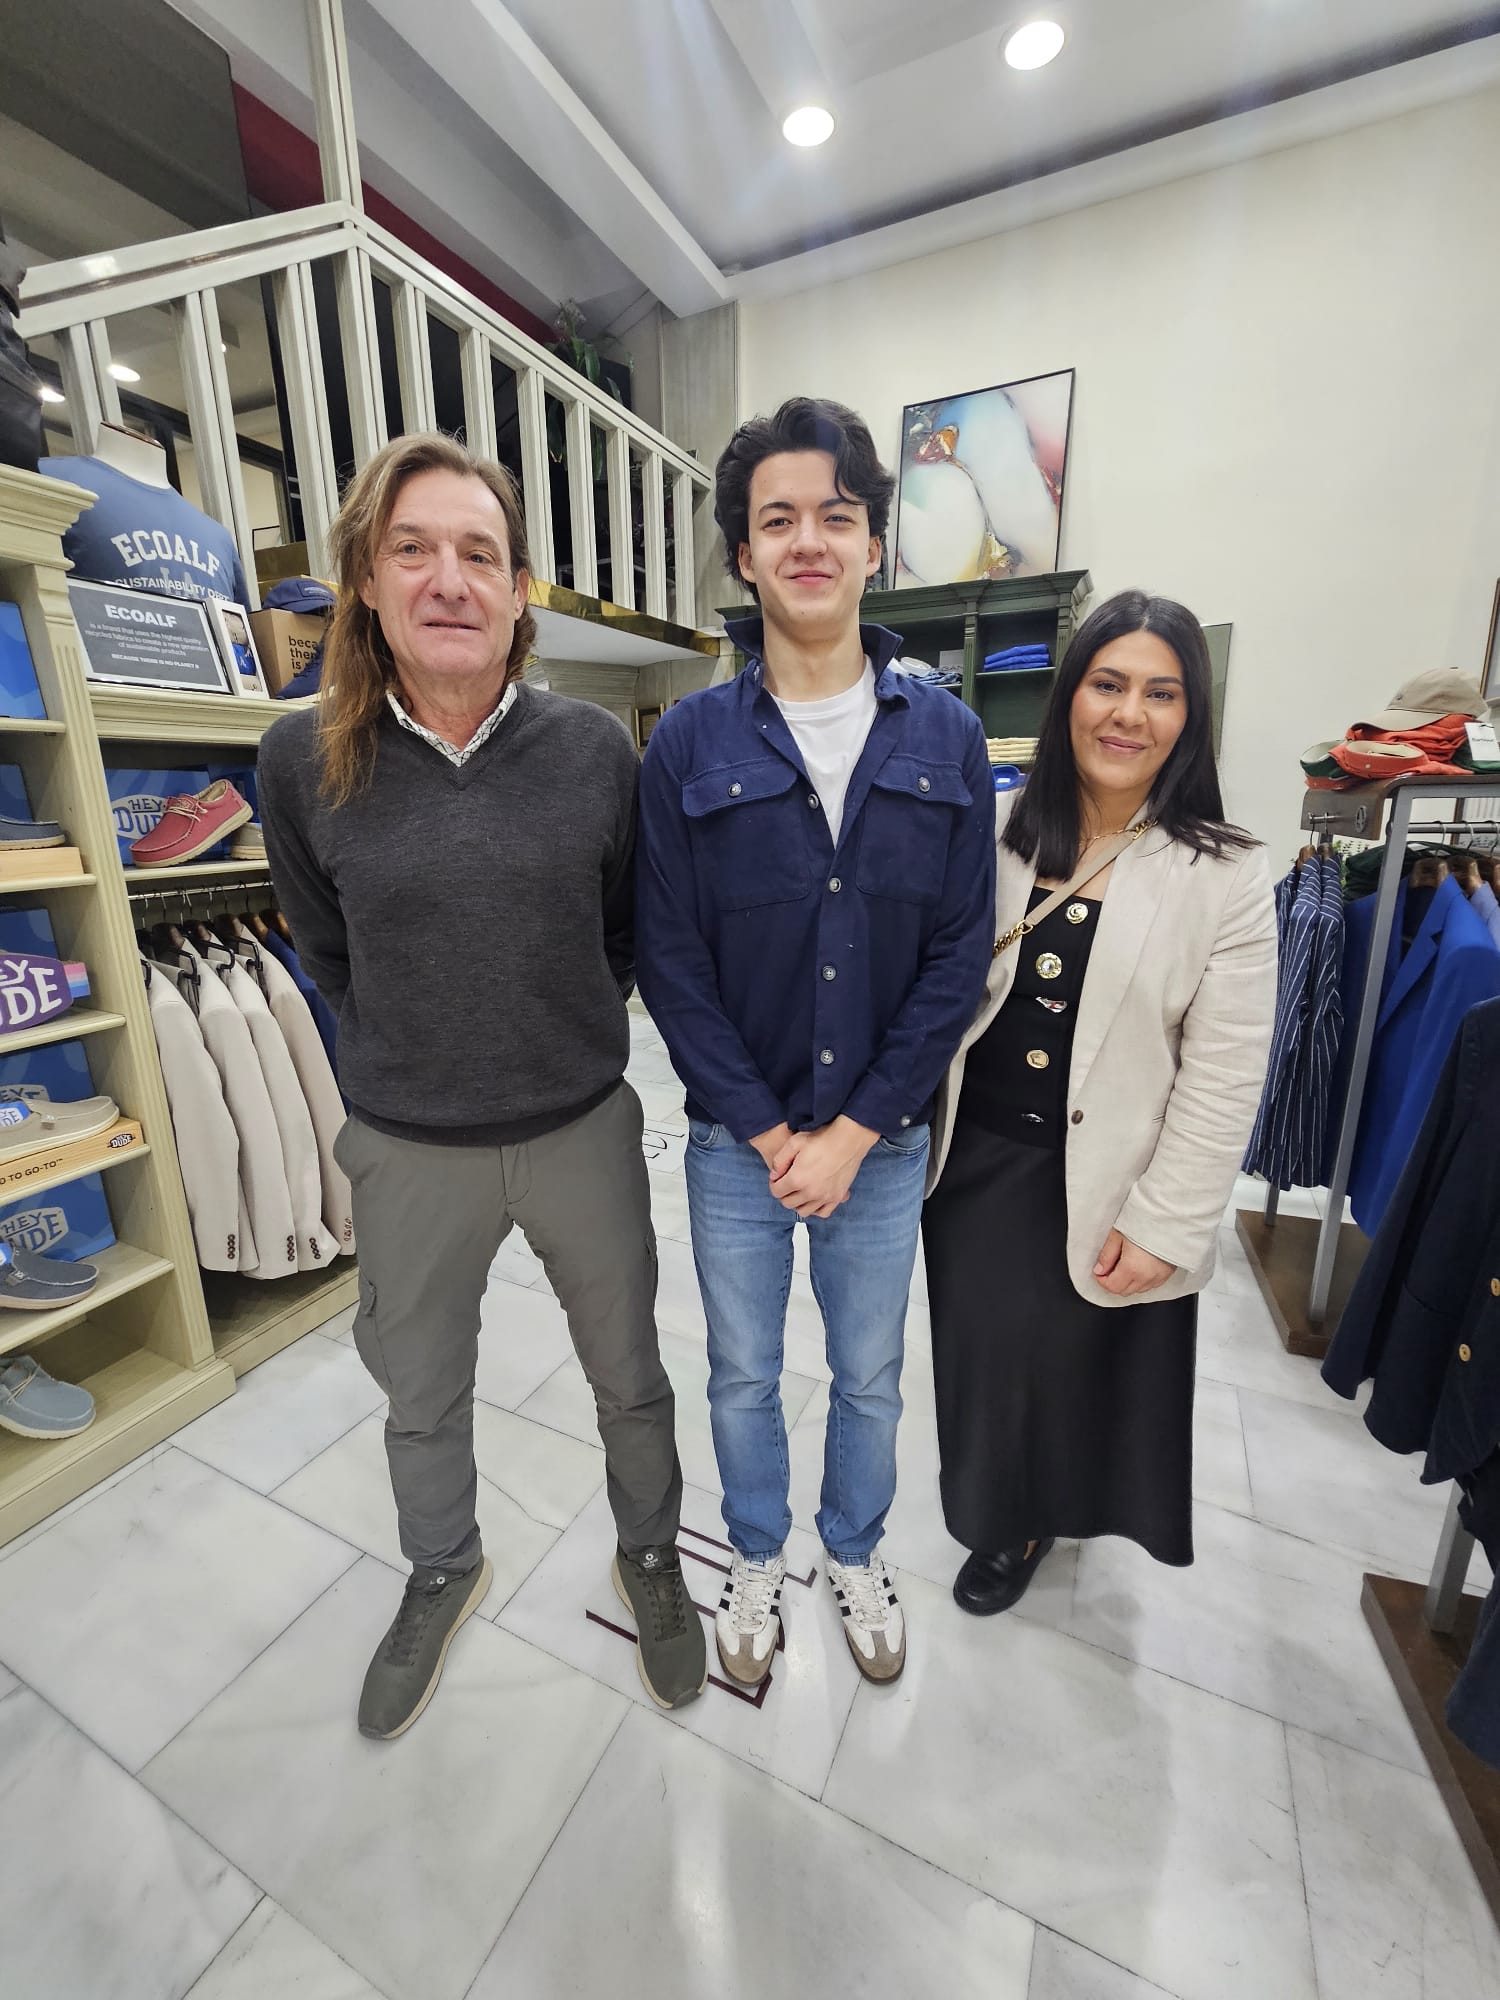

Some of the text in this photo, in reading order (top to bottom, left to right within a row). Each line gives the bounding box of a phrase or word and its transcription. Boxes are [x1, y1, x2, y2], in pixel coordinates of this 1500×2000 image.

[111, 530, 220, 577] ECOALF
[104, 604, 177, 628] ECOALF
[291, 658, 302, 670] is
[128, 798, 162, 811] HEY
[0, 967, 62, 1025] DE
[8, 1172, 23, 1182] TO
[1, 1211, 42, 1234] HEY
